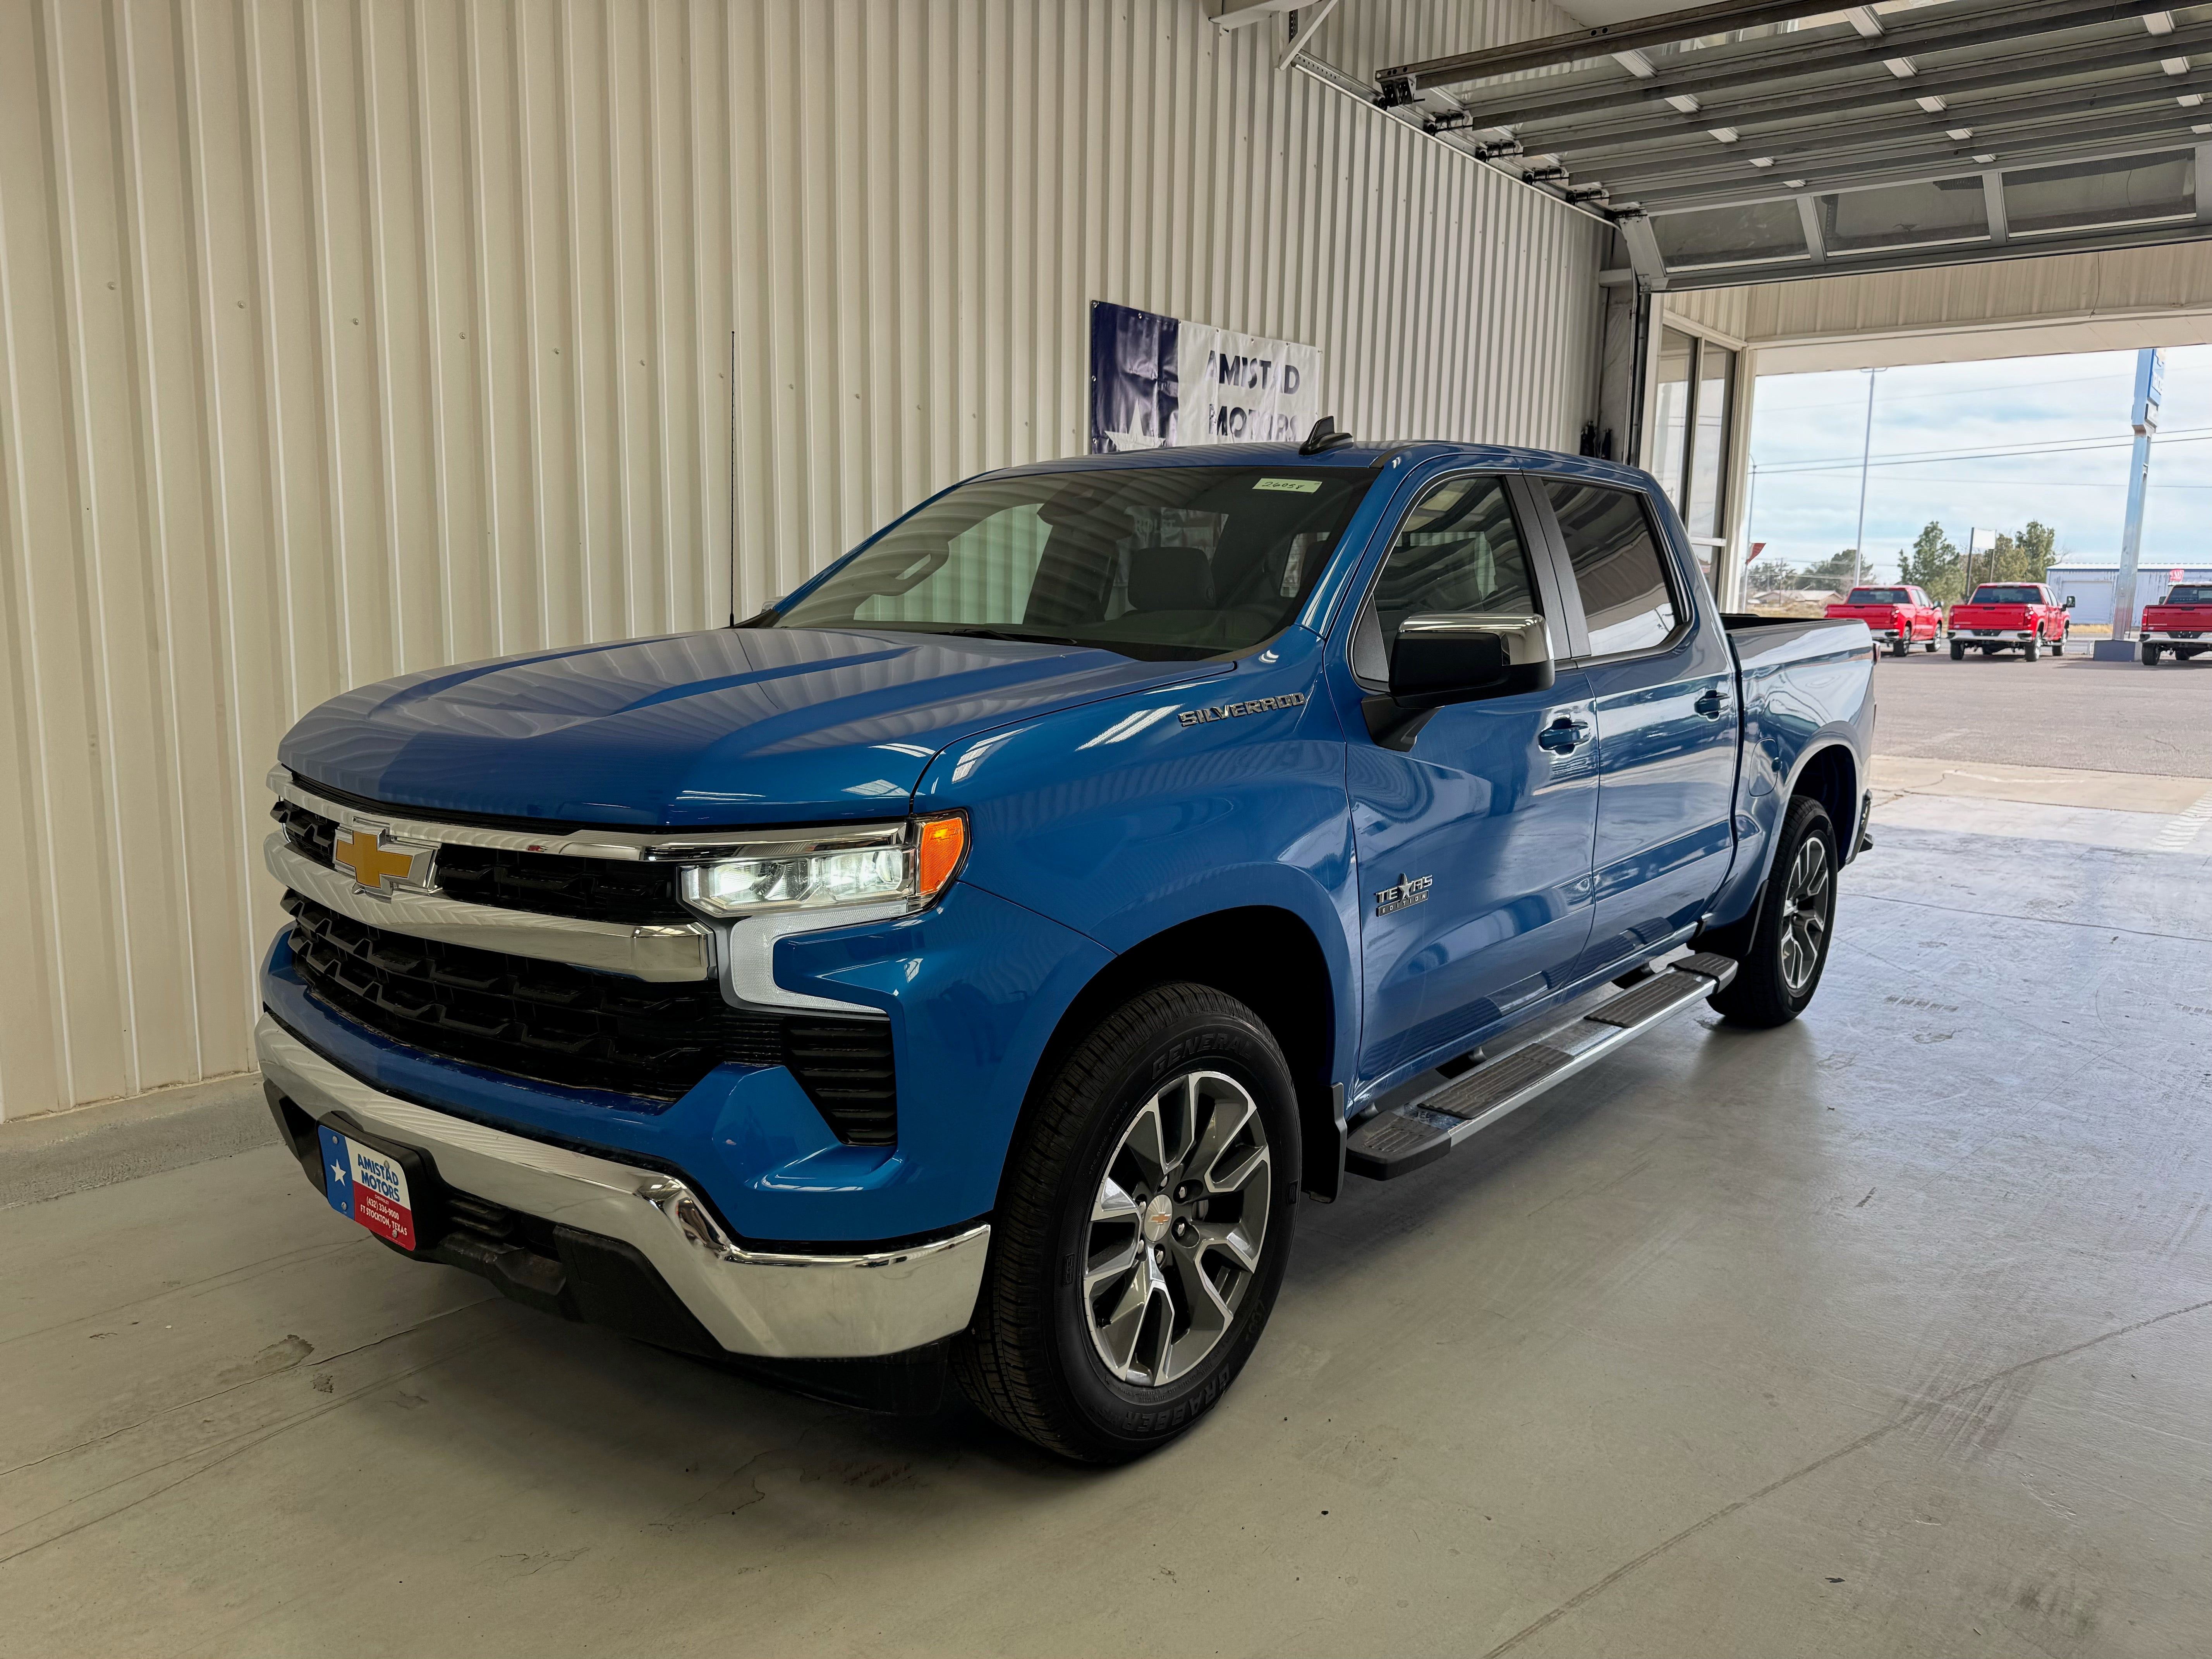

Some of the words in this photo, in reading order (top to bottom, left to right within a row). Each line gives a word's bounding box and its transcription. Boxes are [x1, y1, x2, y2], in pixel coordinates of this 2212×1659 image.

[1178, 692, 1306, 727] SILVERADO
[1374, 873, 1433, 903] TEXAS
[1382, 893, 1426, 914] EDITION
[1152, 1033, 1252, 1079] GENERAL
[357, 1153, 399, 1186] AMISTAD
[361, 1170, 400, 1202] MOTORS
[360, 1204, 366, 1213] FT
[366, 1207, 391, 1229] STOCKTON,
[391, 1221, 408, 1236] TEXAS
[366, 1196, 378, 1211] (432)
[379, 1203, 399, 1220] 336-9000
[1122, 1364, 1230, 1432] GRABBER
